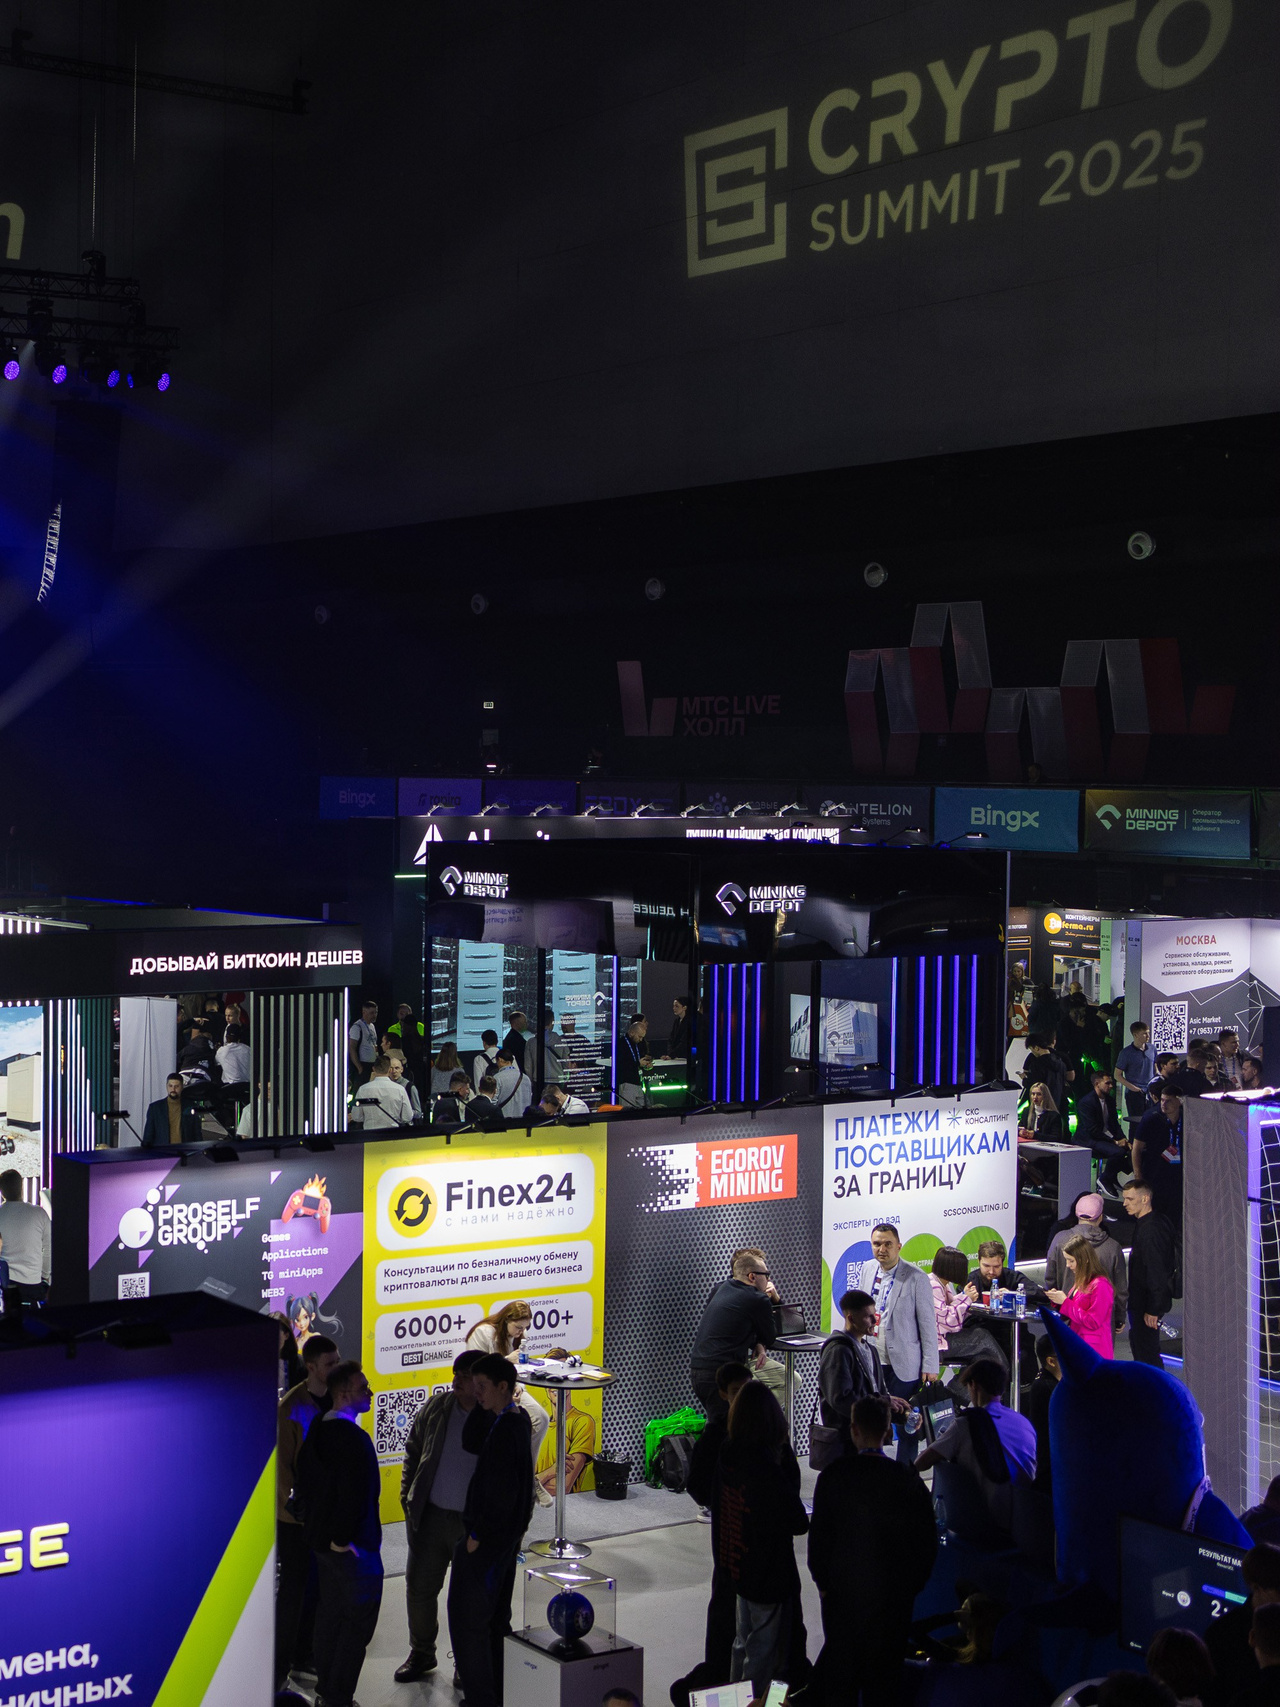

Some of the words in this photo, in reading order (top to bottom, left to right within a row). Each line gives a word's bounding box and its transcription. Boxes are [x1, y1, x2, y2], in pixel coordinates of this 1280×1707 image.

[808, 0, 1233, 175] CRYPTO
[809, 159, 1020, 252] SUMMIT
[1038, 118, 1207, 206] 2025
[733, 695, 781, 714] LIVE
[682, 717, 746, 737] ХОЛЛ
[862, 817, 891, 827] Systems
[1126, 809, 1179, 820] MINING
[1126, 820, 1177, 831] DEPOT
[749, 885, 807, 899] MINING
[749, 899, 805, 913] DEPOT
[1176, 935, 1217, 946] МОСКВА
[130, 952, 218, 975] ДОБЫВАЙ
[223, 953, 301, 970] БИТКОИН
[305, 950, 363, 968] ДЕШЕВ
[1165, 952, 1192, 960] Сервисное
[1193, 950, 1231, 958] обслуживание,
[965, 1108, 980, 1116] СКС
[965, 1113, 1010, 1125] КОНСАЛТИНГ
[835, 1108, 940, 1141] ПЛАТЕЖИ
[711, 1145, 785, 1174] EGOROV
[835, 1130, 1010, 1170] ПОСТАВЩИКАМ
[710, 1169, 783, 1199] MINING
[833, 1174, 862, 1199] ЗА
[869, 1162, 967, 1195] ГРАНИЦУ
[446, 1172, 576, 1212] Finex24
[158, 1197, 260, 1226] PROSELF
[461, 1214, 499, 1226] нами
[507, 1206, 575, 1222] надёжно
[943, 1202, 1009, 1217] SCSCONSULTING.IO
[157, 1219, 231, 1246] GROUP
[833, 1219, 872, 1231] ЭКСПЕРТЫ
[261, 1232, 291, 1243] Games
[261, 1246, 329, 1262] Applications
[261, 1271, 274, 1281] TG
[278, 1266, 323, 1280] miniApps
[384, 1264, 455, 1278] Консультации
[457, 1262, 469, 1273] по
[471, 1252, 541, 1271] безналичному
[543, 1251, 578, 1265] обмену
[383, 1277, 459, 1294] криптовалюты
[461, 1275, 479, 1286] для
[481, 1273, 498, 1282] вас
[499, 1271, 506, 1281] и
[507, 1267, 542, 1281] вашего
[544, 1263, 583, 1276] бизнеса
[261, 1287, 286, 1298] WEB3
[394, 1313, 466, 1340] 6000+
[526, 1309, 573, 1331] 00+
[380, 1340, 436, 1353] положительных
[403, 1352, 423, 1365] BEST
[424, 1349, 453, 1361] CHANGE
[1198, 1547, 1231, 1564] РЕЗУЛЬТАТ
[1211, 1599, 1222, 1618] 2
